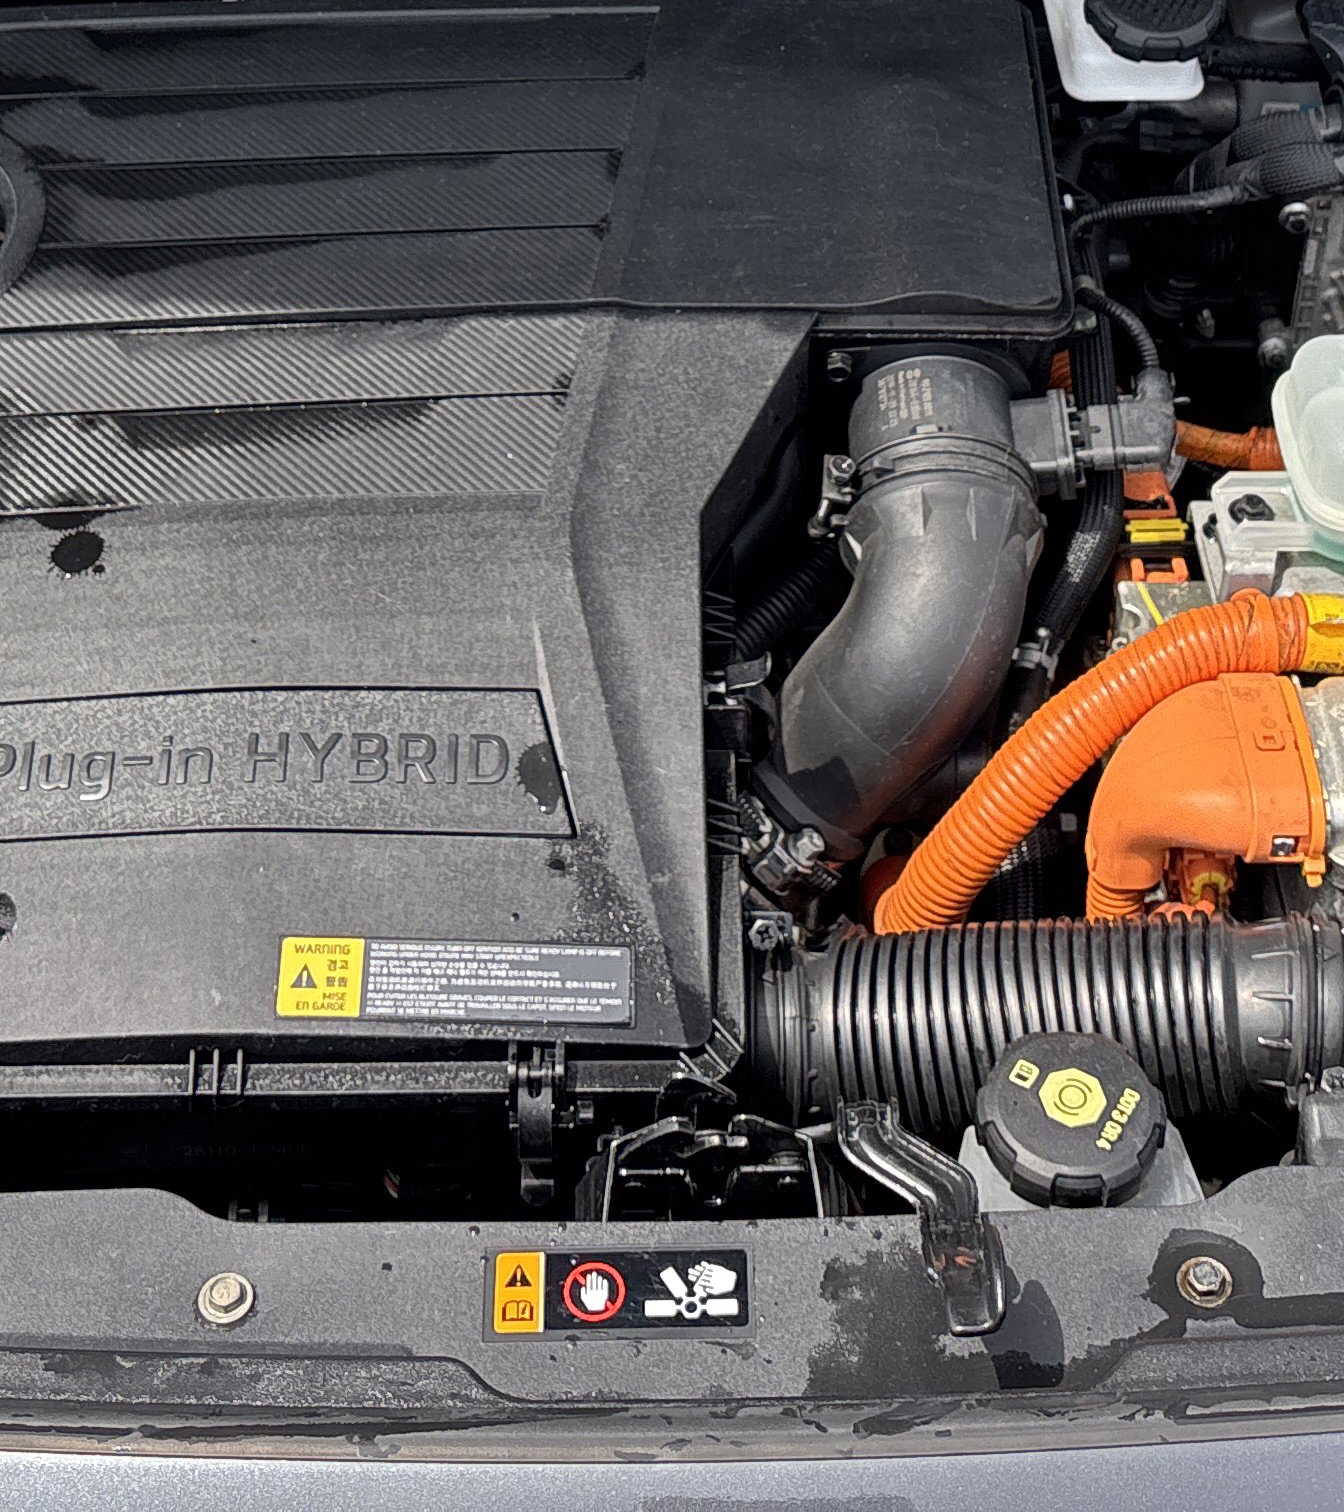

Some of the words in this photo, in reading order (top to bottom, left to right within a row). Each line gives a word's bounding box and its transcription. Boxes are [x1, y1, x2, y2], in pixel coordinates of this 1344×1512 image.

[243, 731, 511, 785] HYBRID
[294, 943, 351, 956] WARNING
[322, 992, 347, 1002] MISE
[296, 1000, 310, 1011] EN
[312, 1001, 346, 1012] GARDE
[1100, 1120, 1123, 1142] OR
[1095, 1137, 1112, 1152] 4
